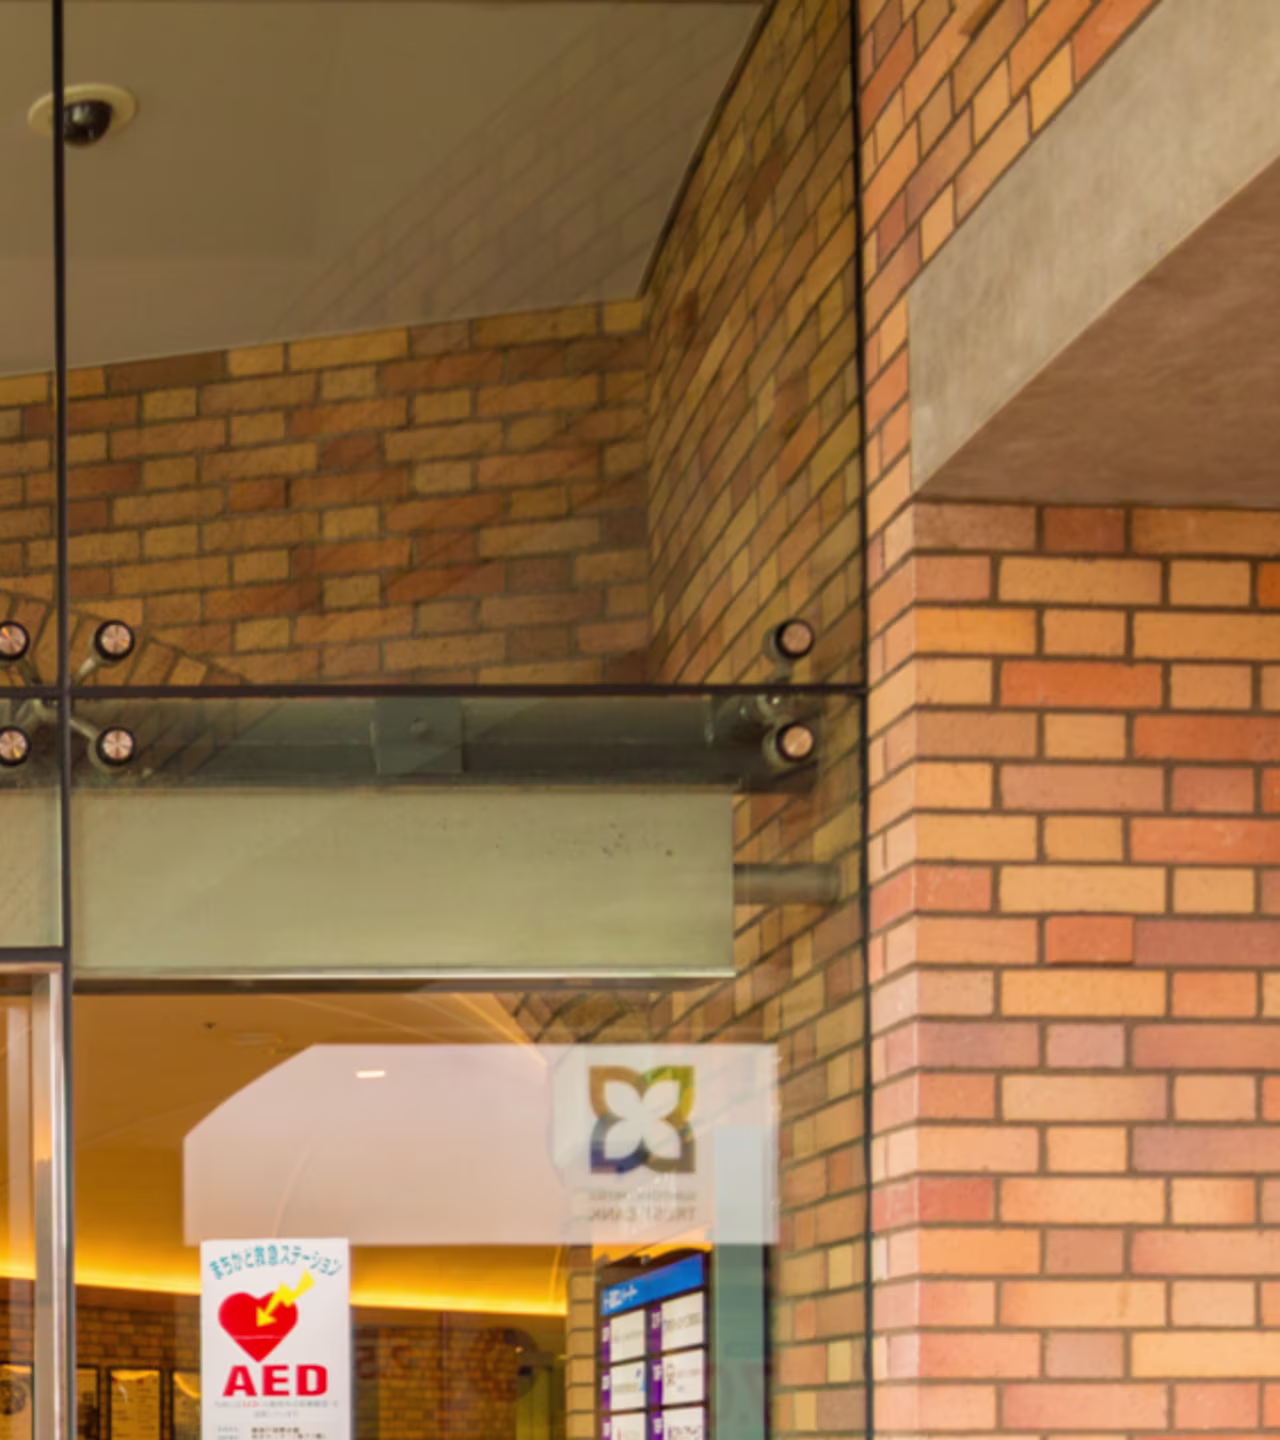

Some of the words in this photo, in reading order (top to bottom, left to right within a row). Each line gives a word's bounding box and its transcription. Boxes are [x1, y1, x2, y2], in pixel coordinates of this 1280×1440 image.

[209, 1244, 343, 1280] まちかど救急ステーション
[222, 1363, 329, 1397] AED
